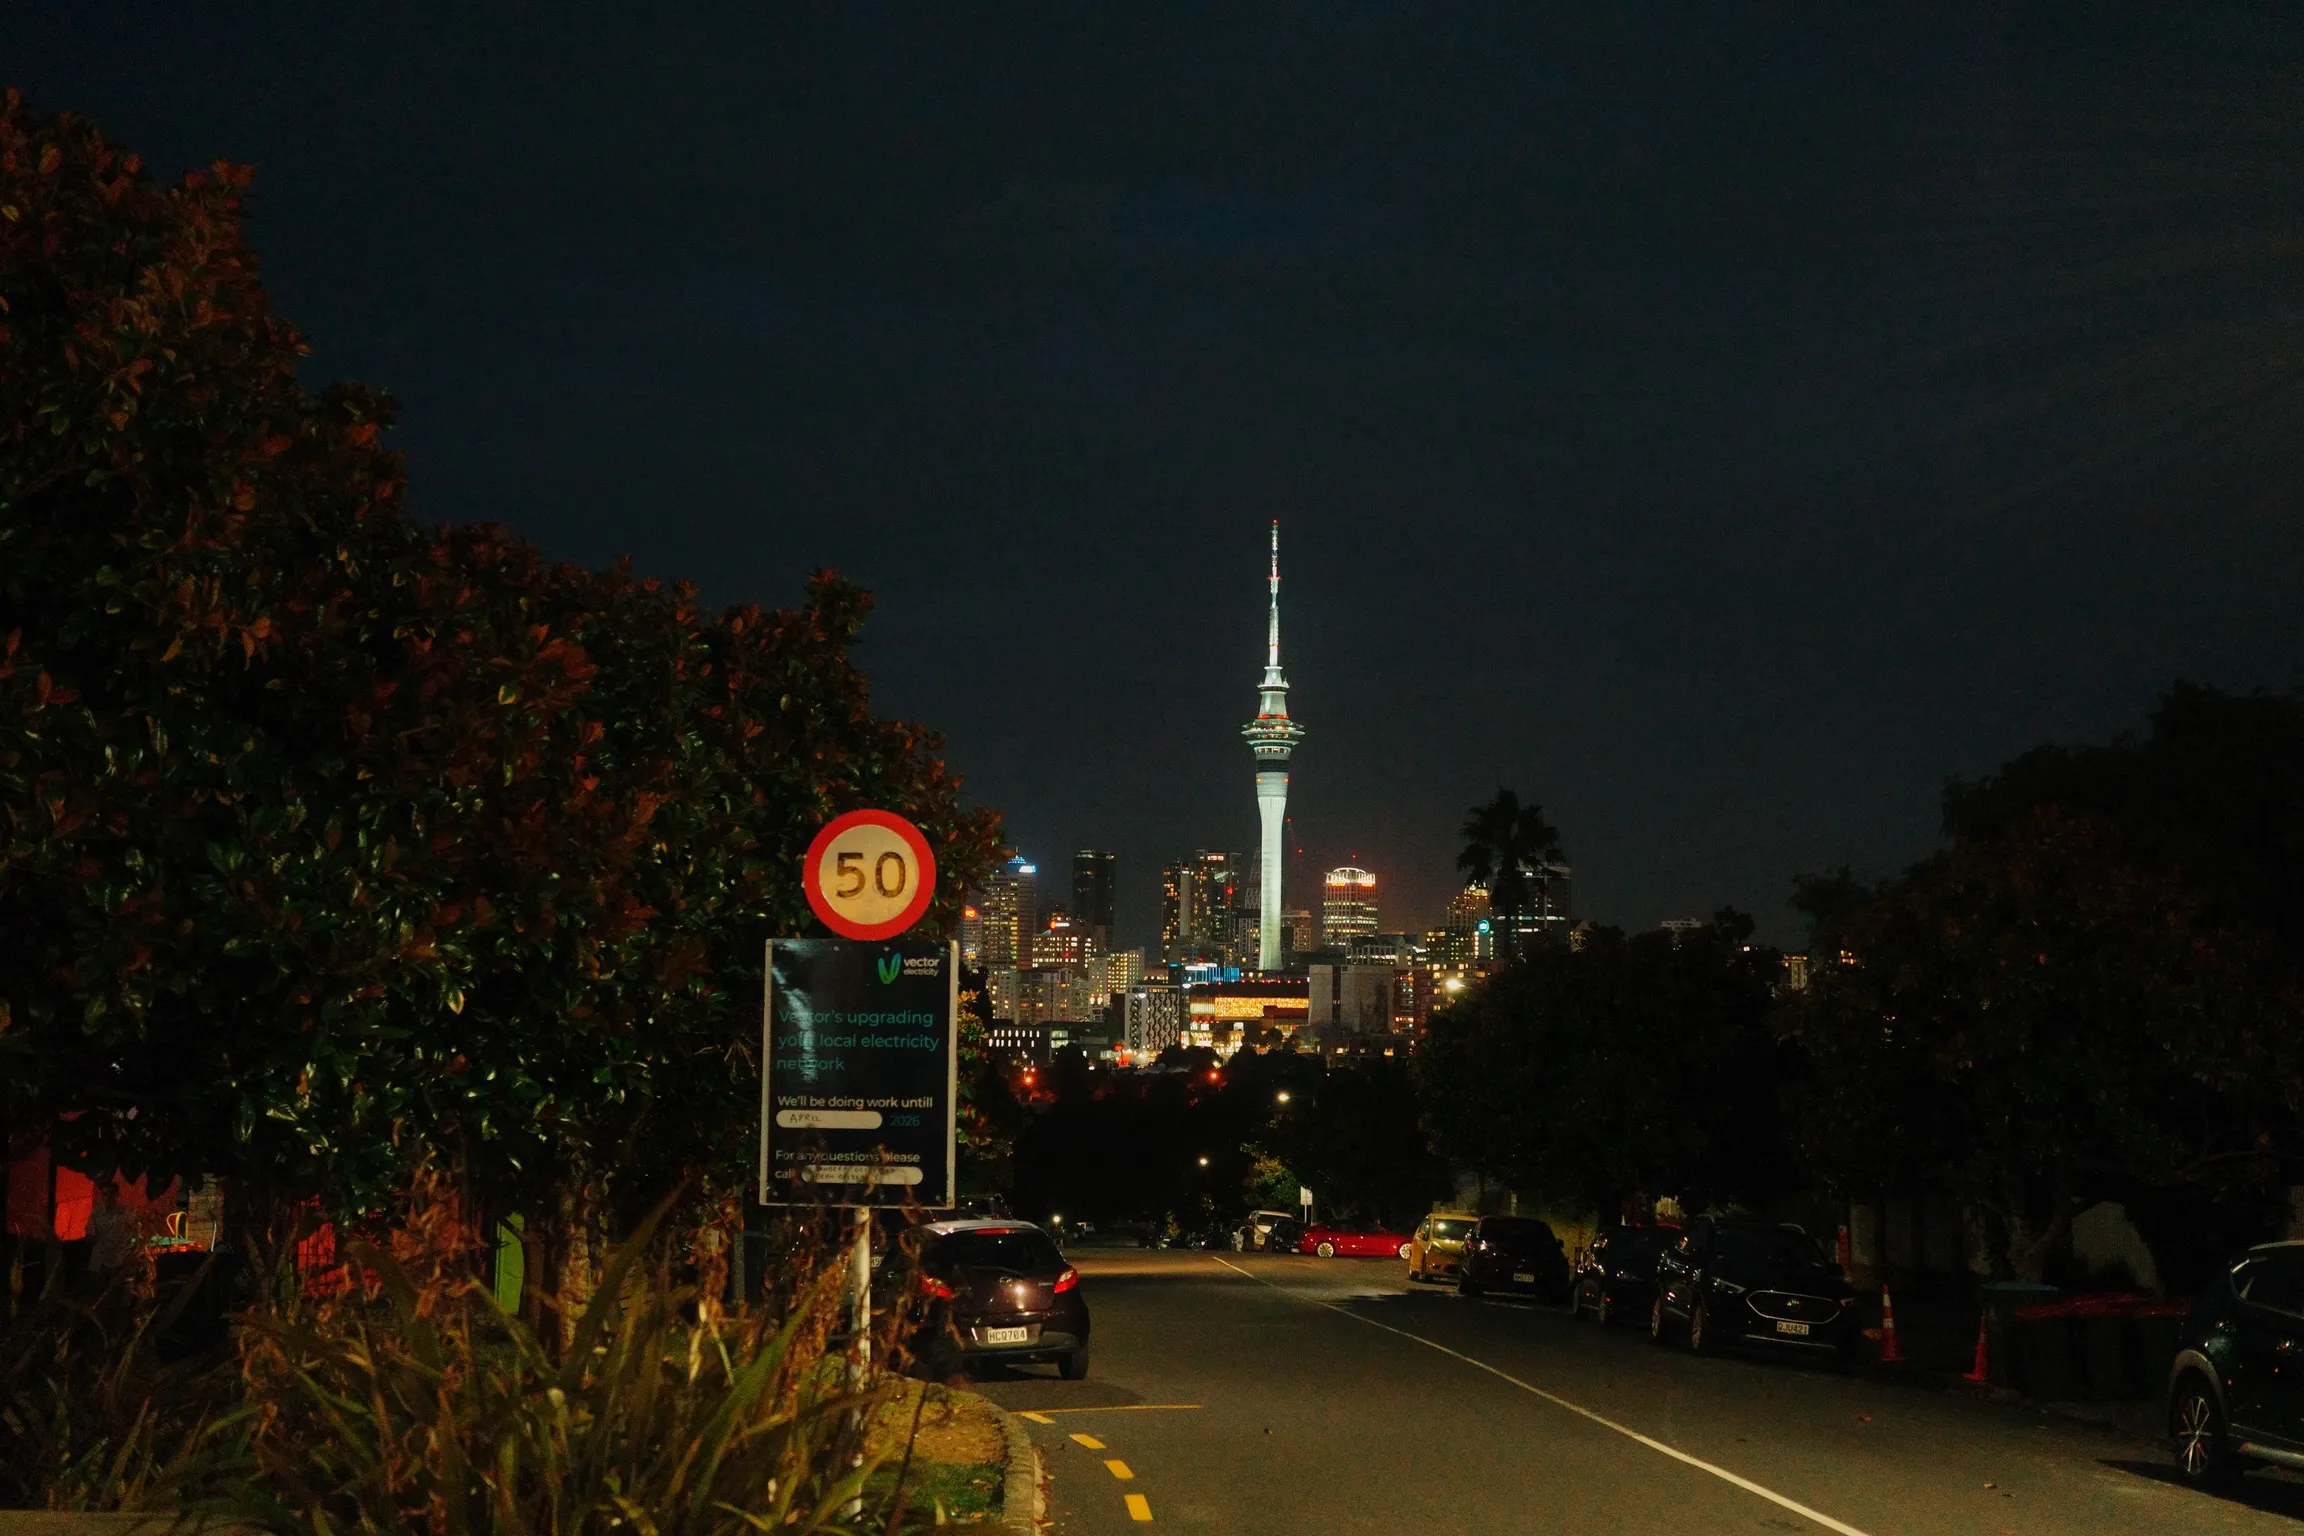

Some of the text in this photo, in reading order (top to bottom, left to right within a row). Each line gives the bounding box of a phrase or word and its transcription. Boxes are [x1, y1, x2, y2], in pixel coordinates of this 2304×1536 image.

[835, 851, 906, 899] 50
[903, 957, 940, 967] vector
[903, 968, 939, 977] electricity
[778, 1009, 933, 1028] Vetor's upgrading
[778, 1033, 939, 1051] you local electricity
[777, 1095, 933, 1110] We'll be doing work untill
[890, 1115, 920, 1127] 2026
[775, 1150, 794, 1161] For
